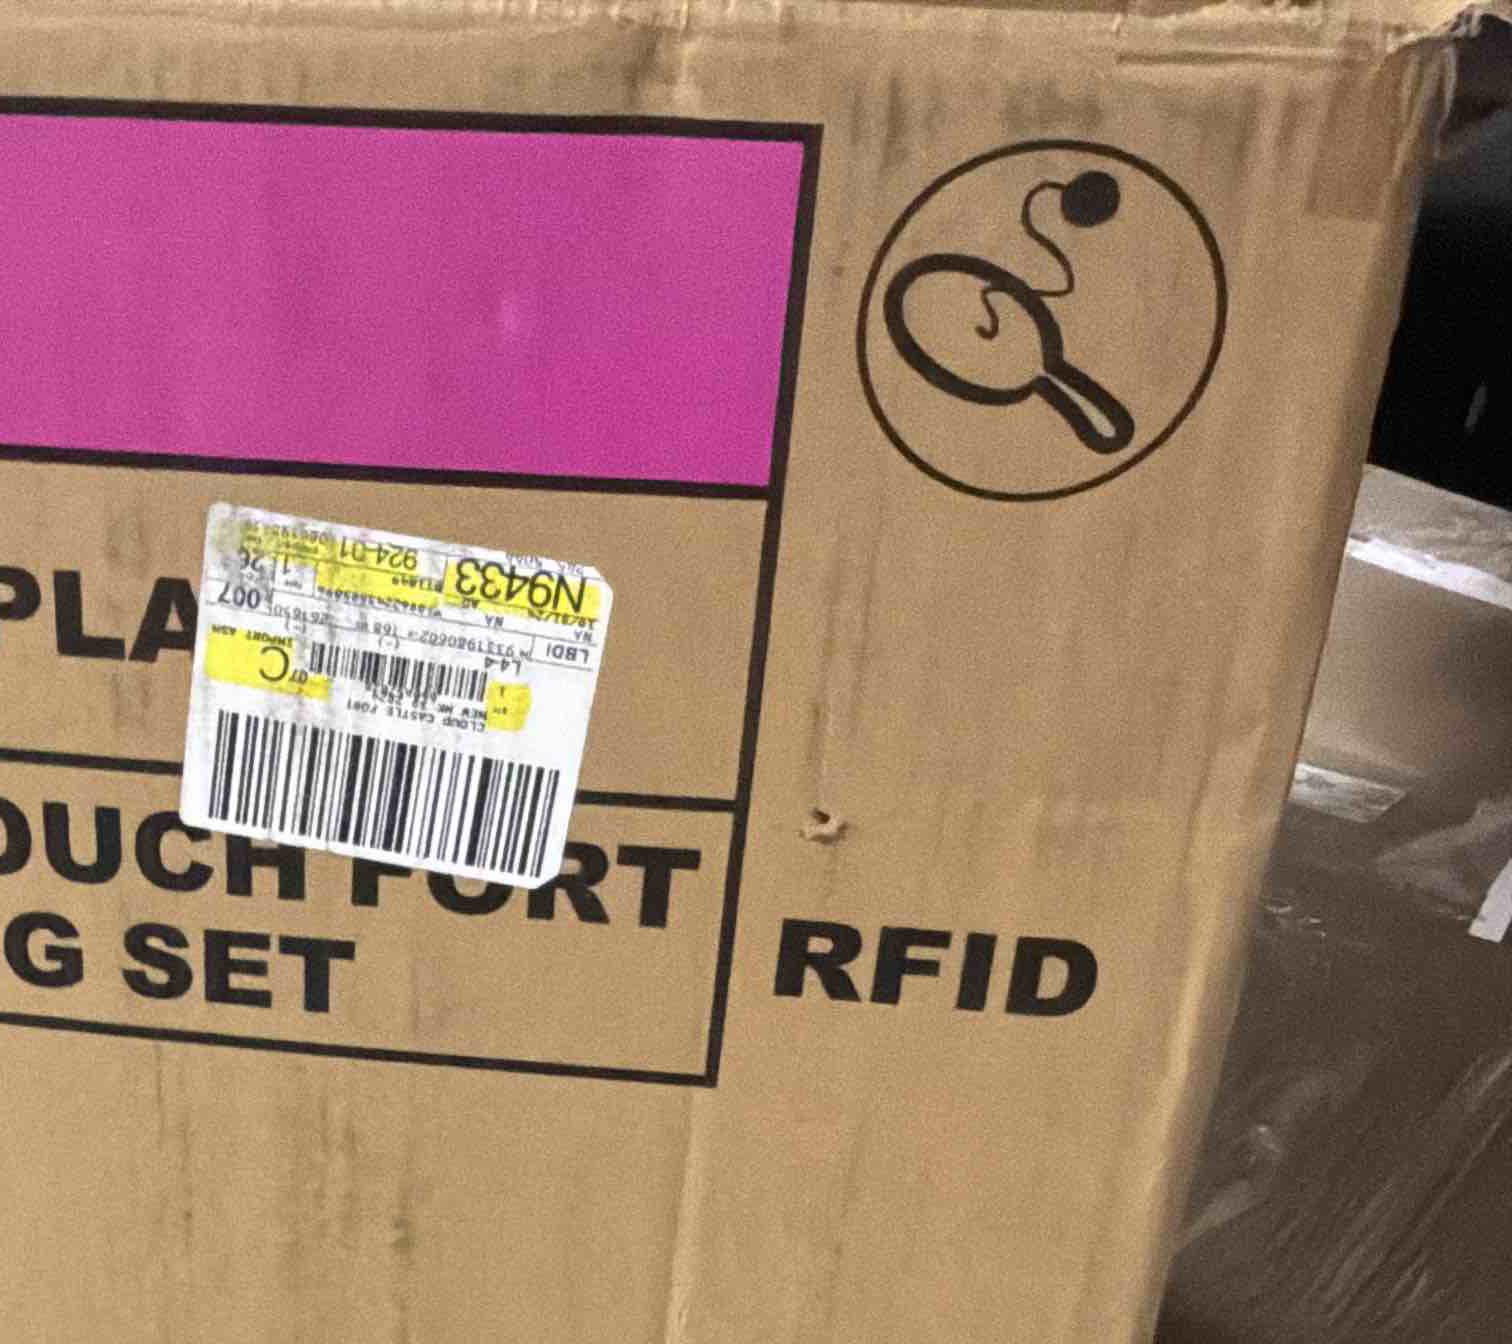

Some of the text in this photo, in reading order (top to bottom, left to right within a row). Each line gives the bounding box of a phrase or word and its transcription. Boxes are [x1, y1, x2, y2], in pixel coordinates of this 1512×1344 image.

[216, 580, 262, 609] 007
[455, 557, 586, 612] N9433
[256, 644, 291, 684] C
[383, 705, 435, 723] CASTLE
[442, 716, 485, 732] CLOUD
[121, 922, 355, 1013] SET
[773, 917, 1099, 1017] RFID
